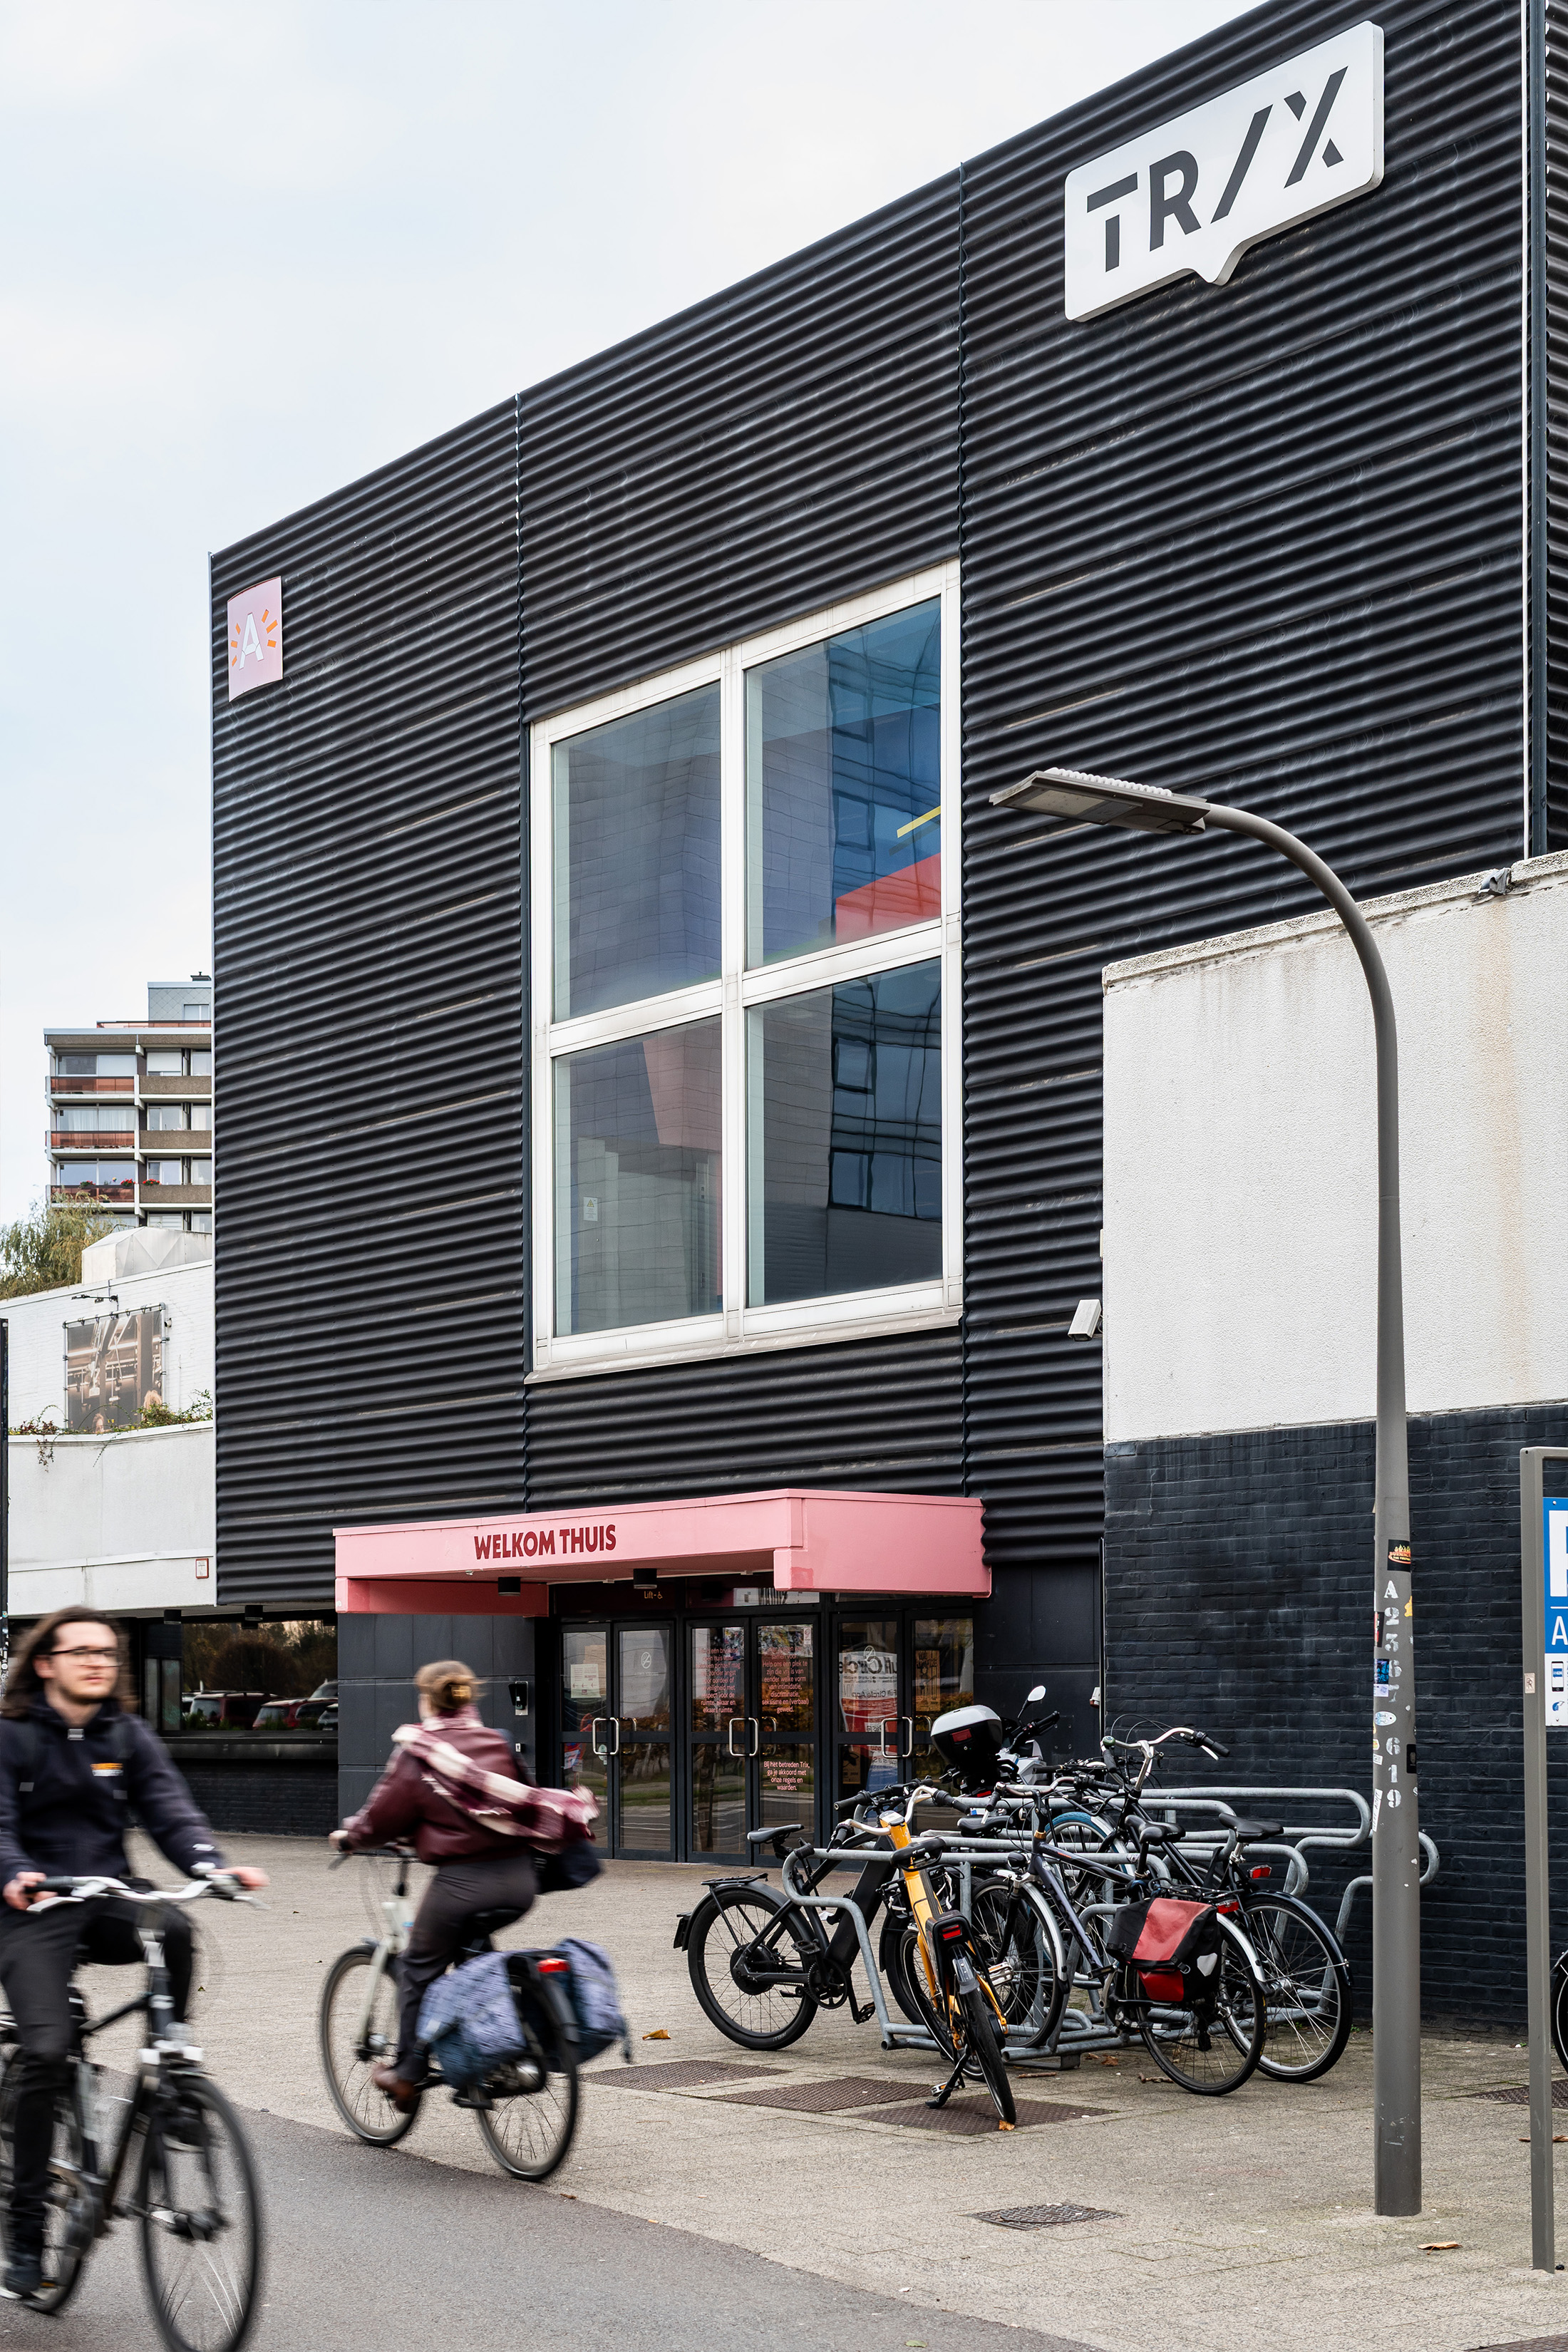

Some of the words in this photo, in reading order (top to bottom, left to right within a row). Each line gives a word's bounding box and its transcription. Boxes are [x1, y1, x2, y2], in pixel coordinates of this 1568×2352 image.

[474, 1530, 555, 1560] WELKOM
[559, 1524, 617, 1554] THUIS
[773, 1768, 778, 1777] je
